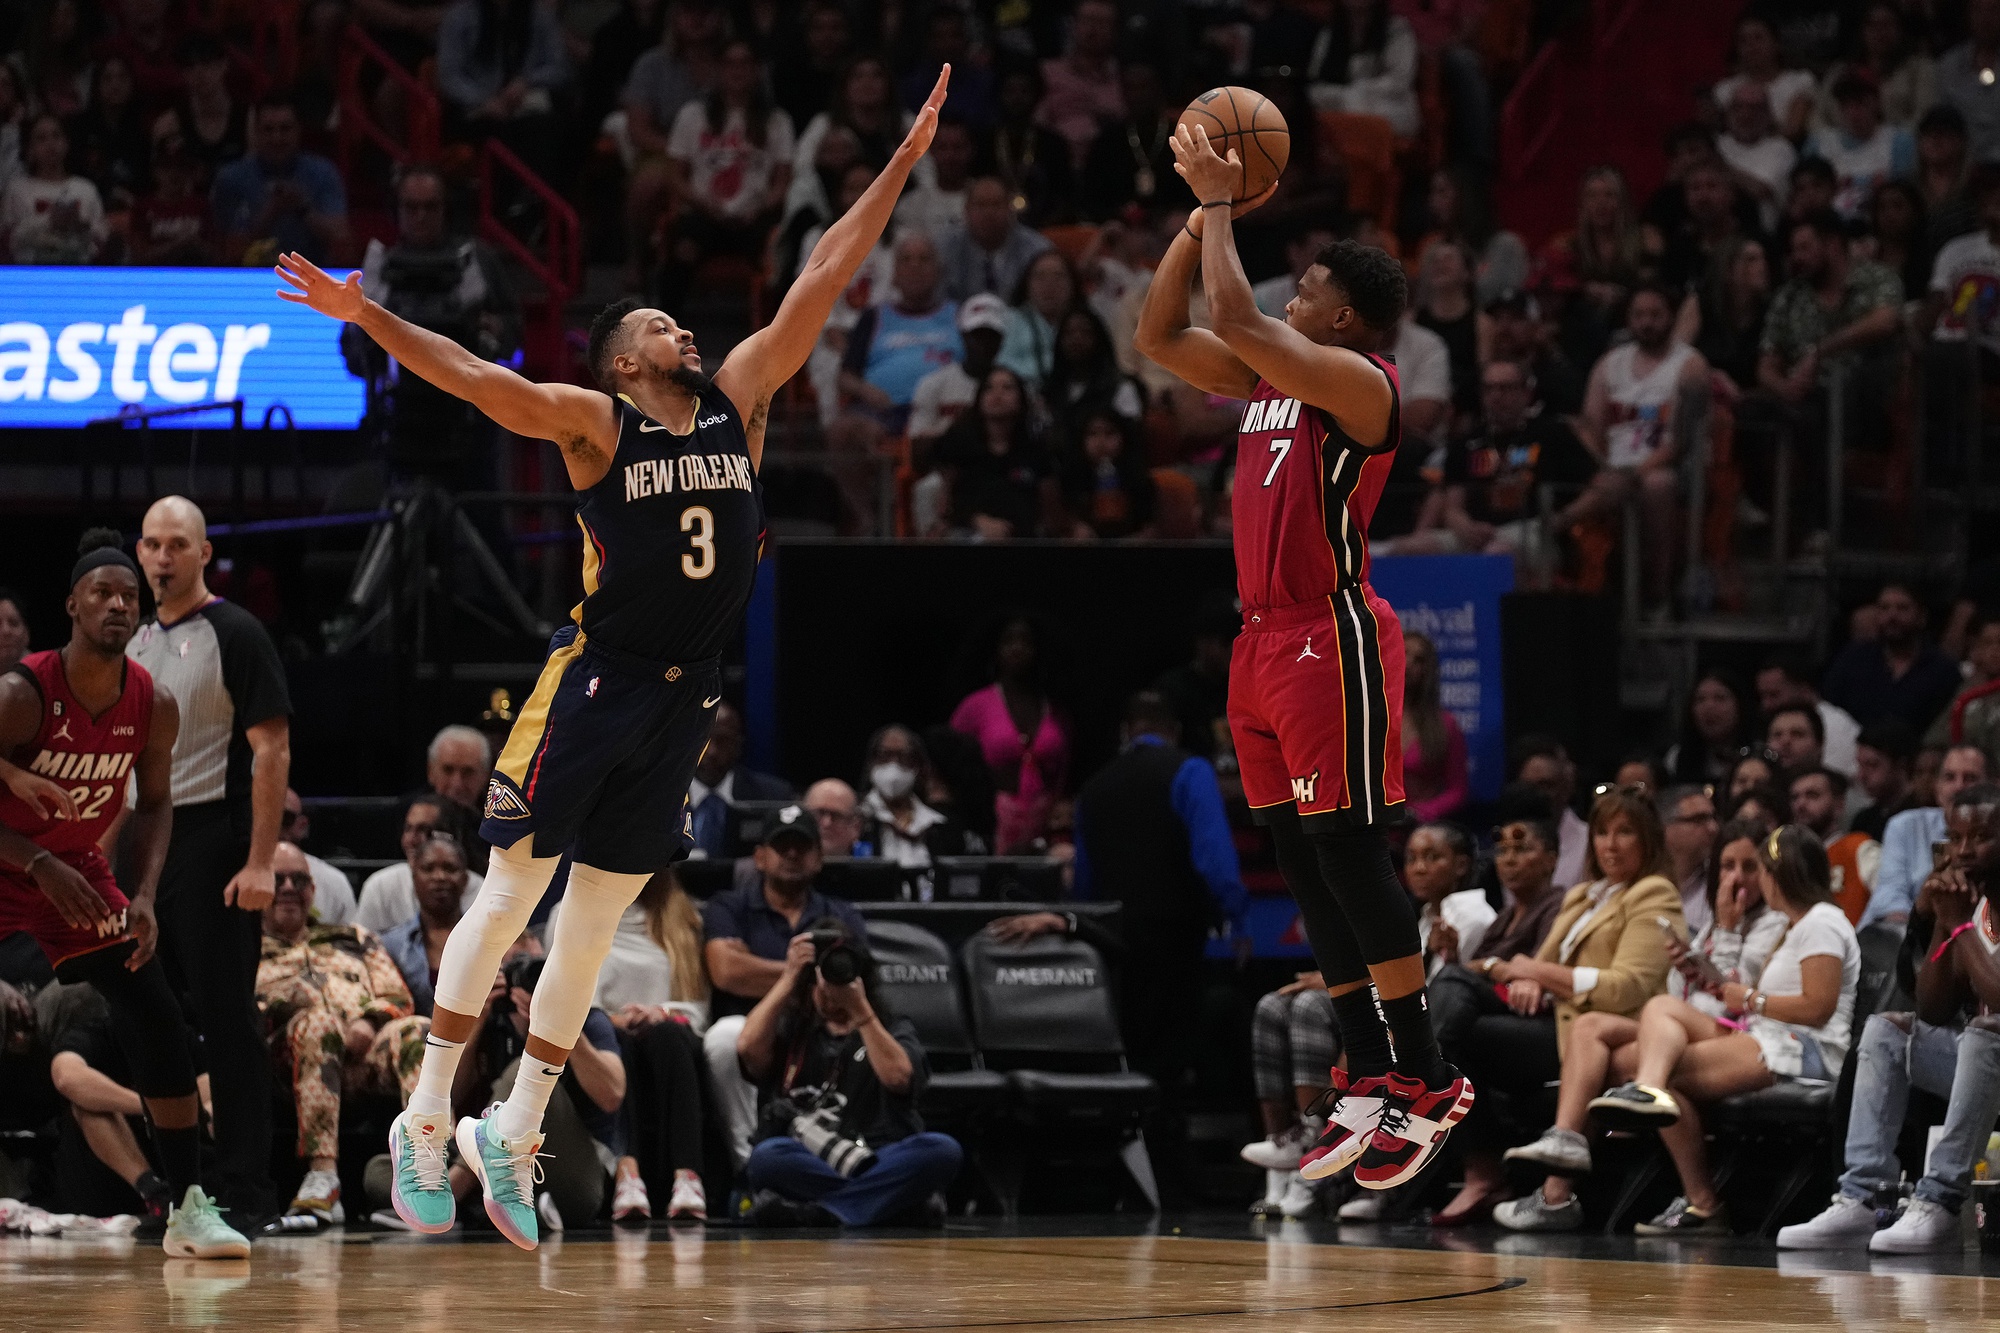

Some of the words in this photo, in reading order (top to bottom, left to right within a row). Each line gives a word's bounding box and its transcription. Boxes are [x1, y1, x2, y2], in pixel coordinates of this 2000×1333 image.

[0, 304, 271, 402] aster
[1239, 397, 1303, 434] IAMI
[624, 457, 674, 503] NEW
[677, 453, 752, 493] ORLEANS
[1262, 438, 1293, 487] 7
[679, 504, 717, 580] 3
[53, 701, 63, 716] 6
[112, 725, 135, 736] UKG
[29, 749, 134, 781] MIAMI
[54, 784, 115, 820] 22
[995, 967, 1096, 986] AMERANT
